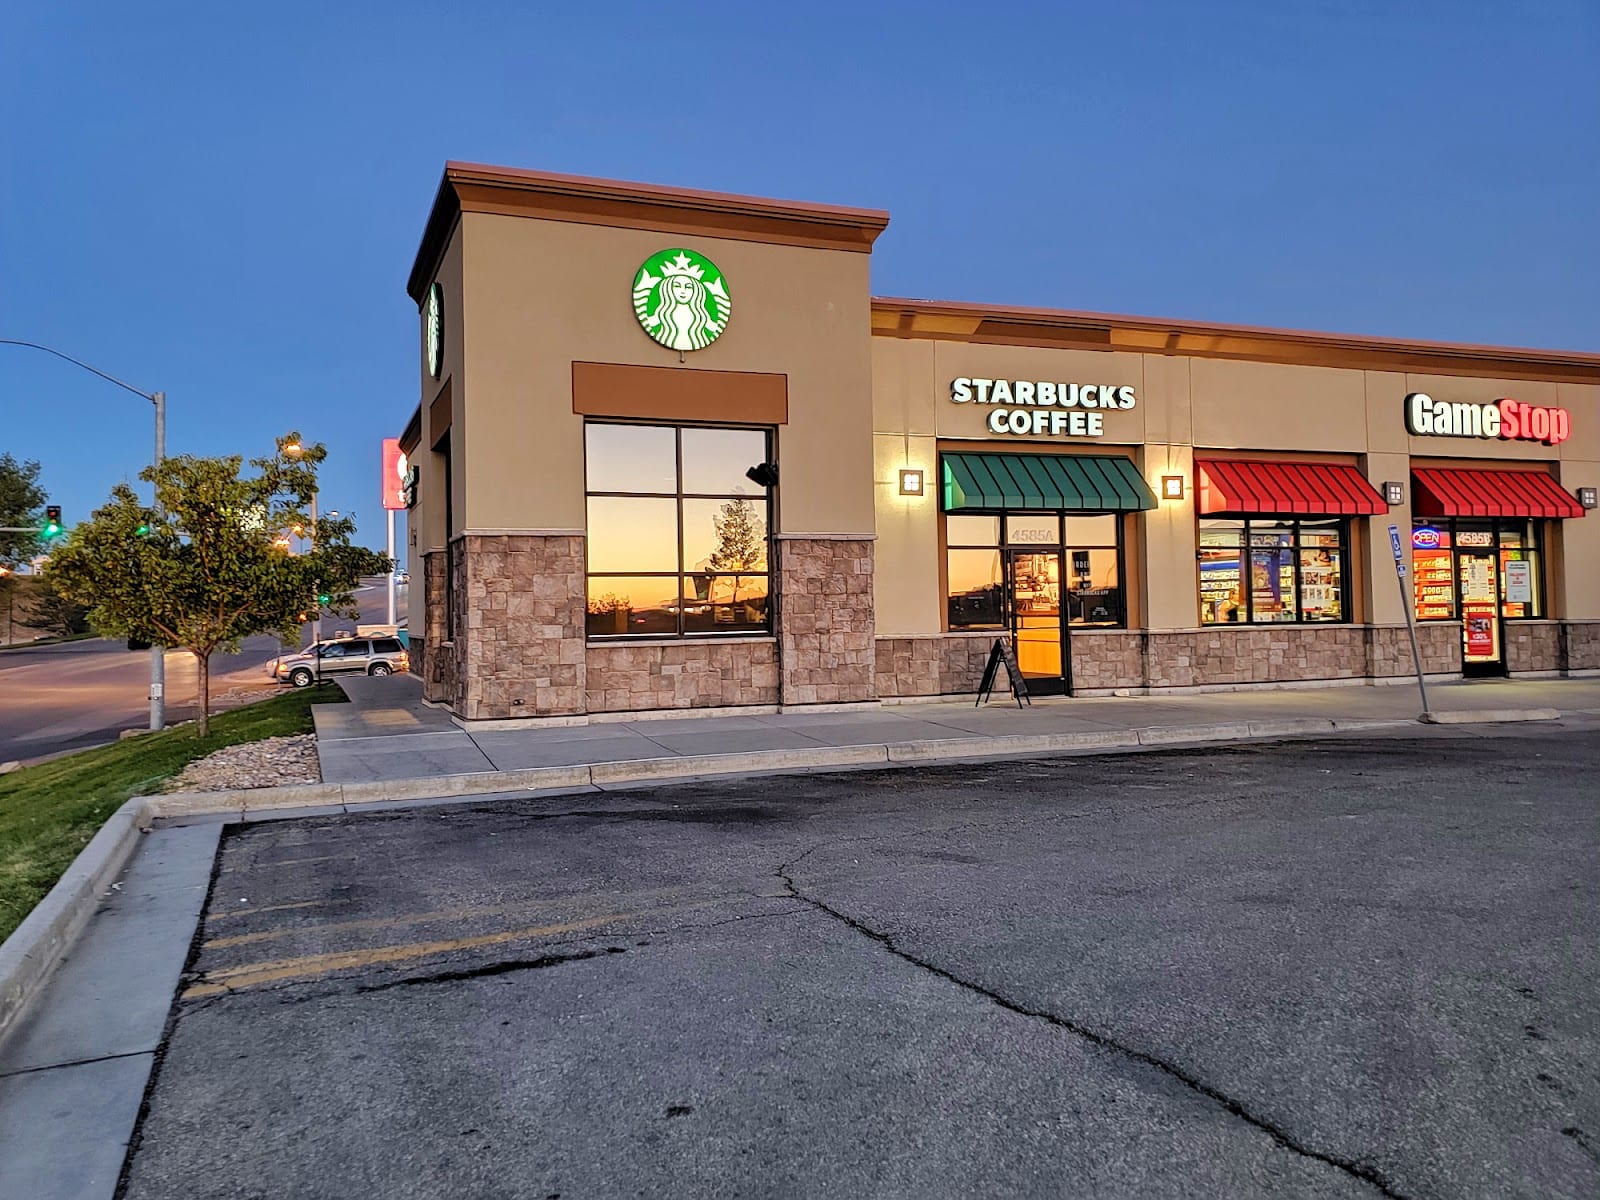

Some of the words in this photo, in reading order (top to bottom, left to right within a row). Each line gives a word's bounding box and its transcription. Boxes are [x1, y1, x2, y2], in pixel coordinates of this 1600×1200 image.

[951, 377, 1136, 410] STARBUCKS
[988, 408, 1104, 436] COFFEE
[1407, 393, 1571, 445] GameStop
[1011, 529, 1054, 542] 4585A
[1412, 531, 1440, 545] OPEN
